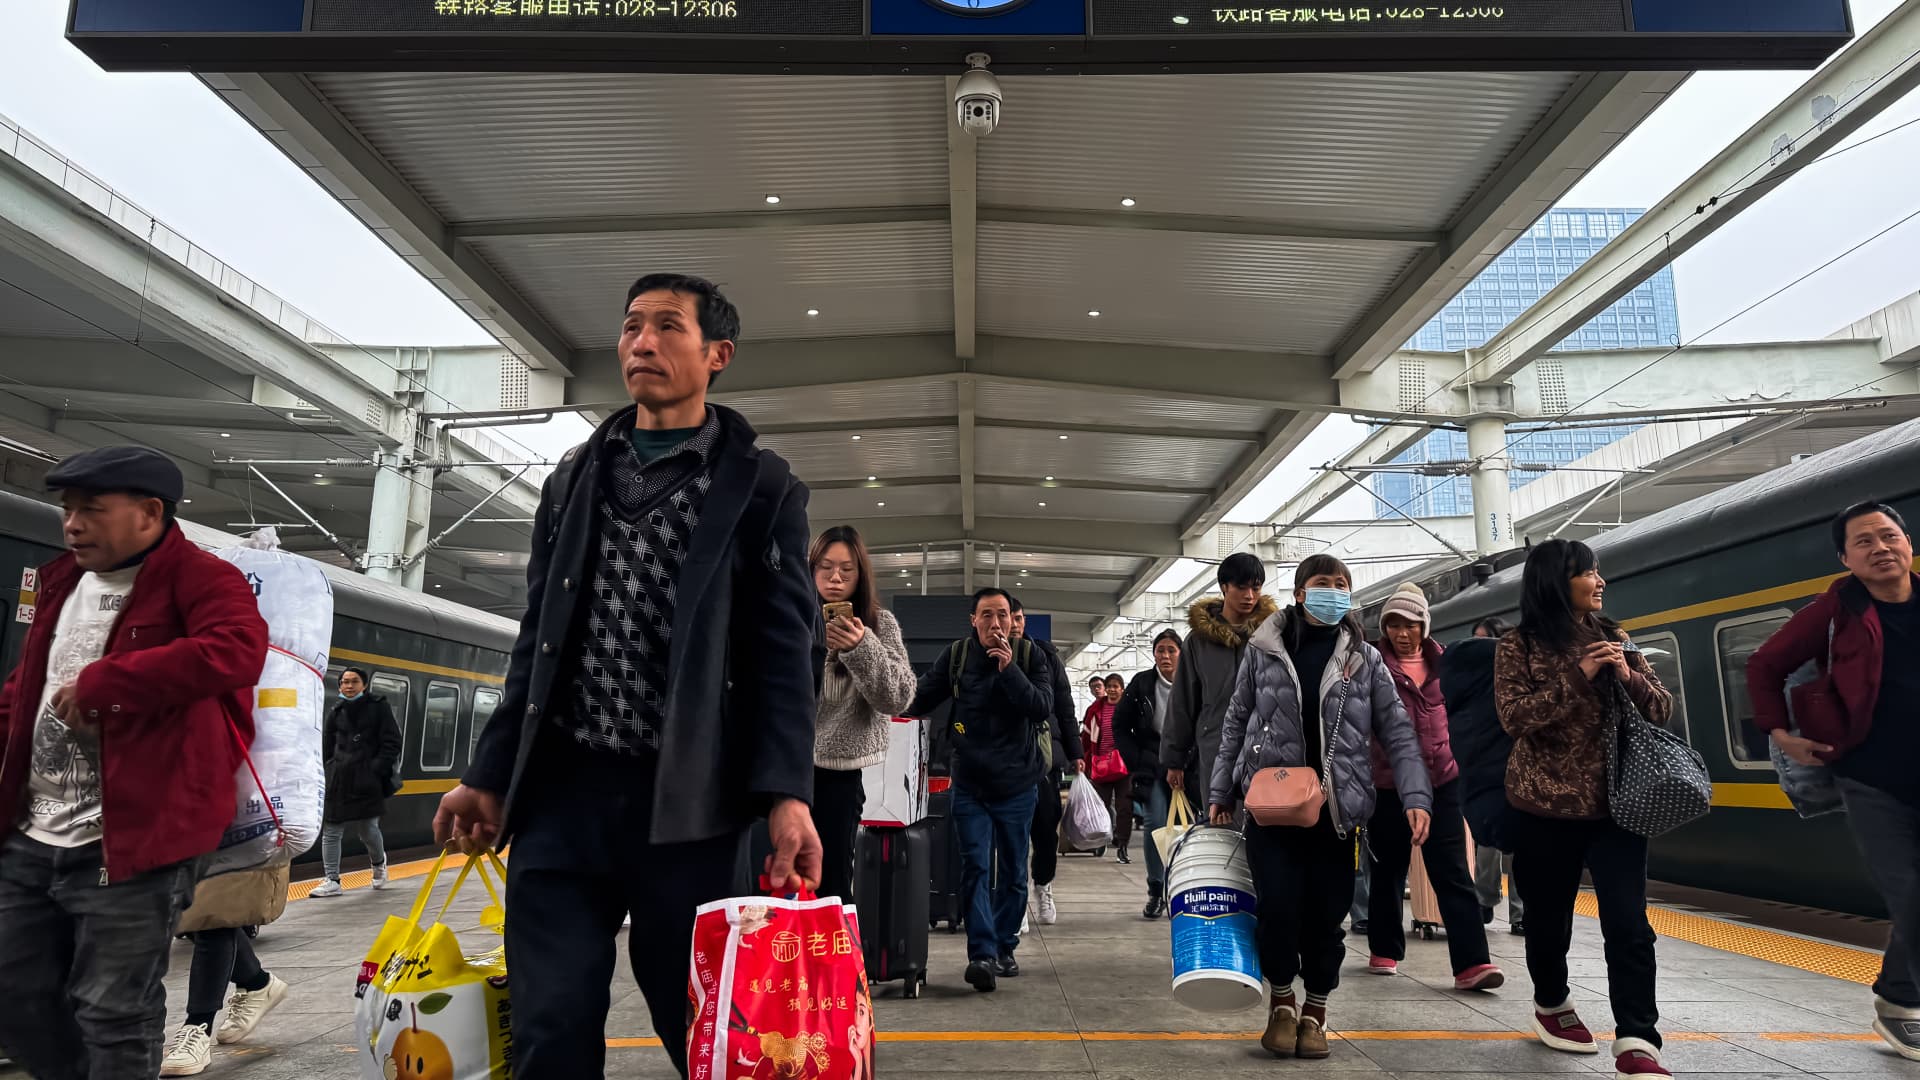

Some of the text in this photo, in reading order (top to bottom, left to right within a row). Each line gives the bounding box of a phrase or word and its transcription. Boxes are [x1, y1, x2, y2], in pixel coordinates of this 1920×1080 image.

[23, 572, 34, 588] 12
[1208, 891, 1238, 904] paint
[807, 928, 852, 957] 老庙
